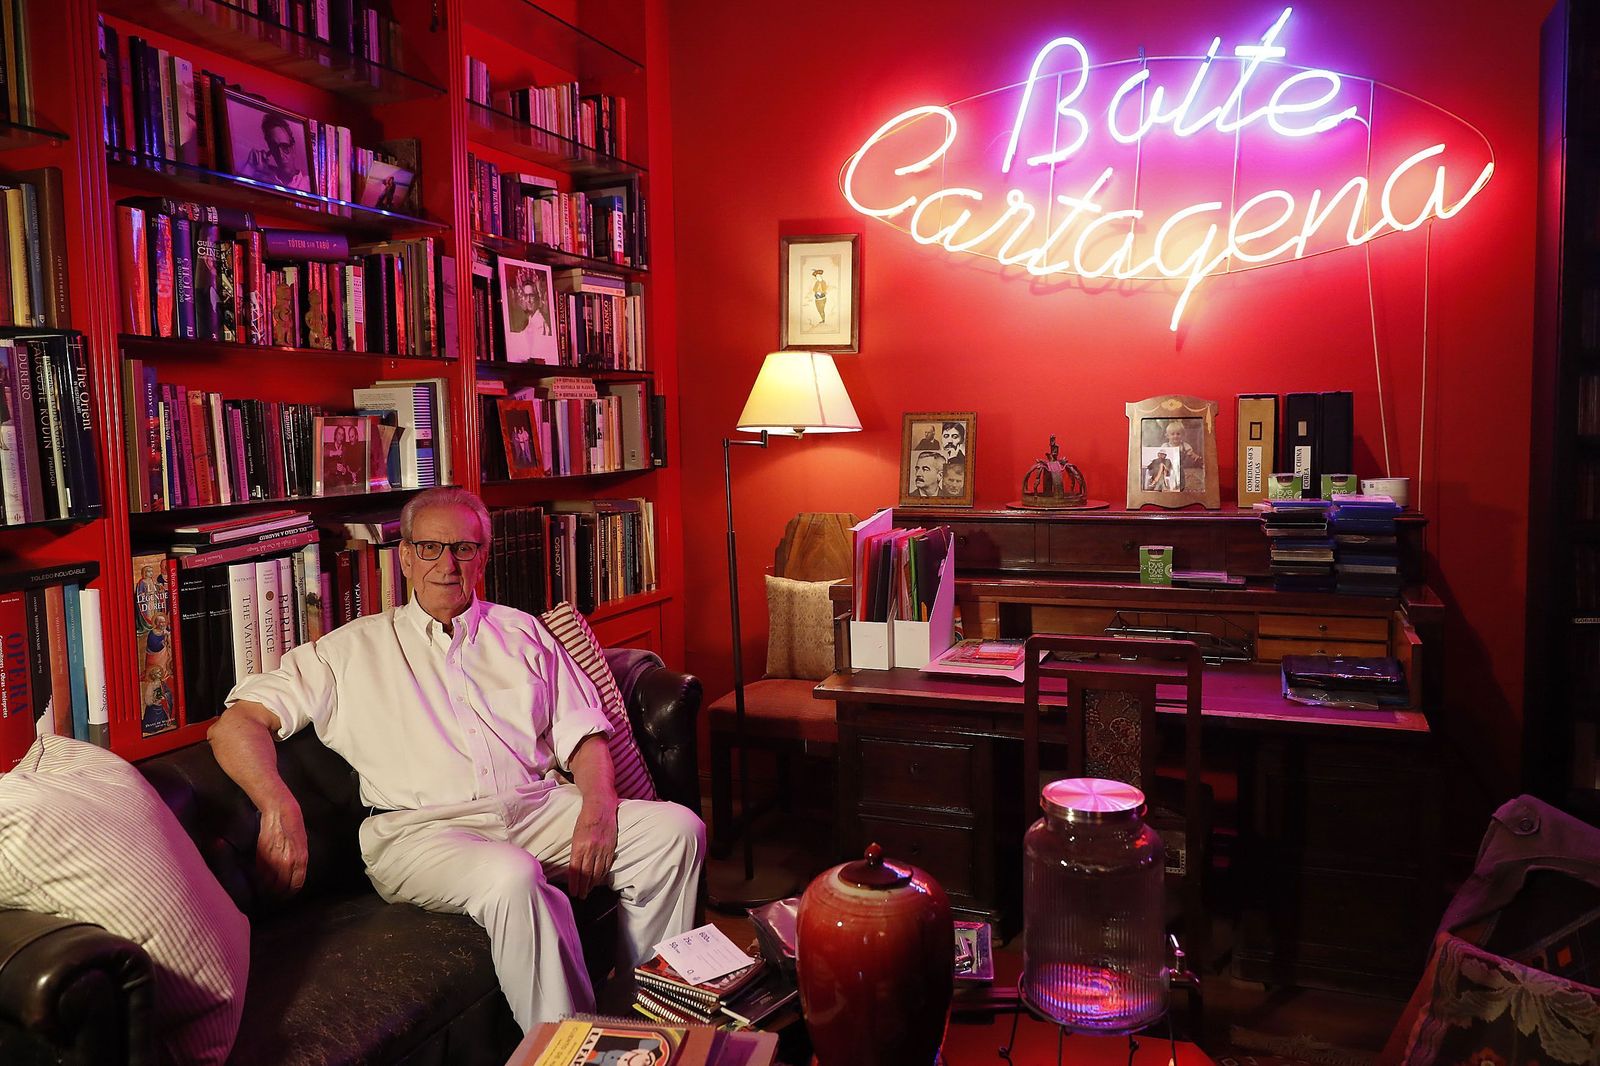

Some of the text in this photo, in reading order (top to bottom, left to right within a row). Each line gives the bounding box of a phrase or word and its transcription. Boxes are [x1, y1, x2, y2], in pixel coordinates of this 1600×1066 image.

[1002, 7, 1358, 173] Boite
[616, 213, 624, 249] PUENTE
[843, 104, 1495, 331] Cartagena
[197, 247, 220, 258] CINE
[18, 353, 31, 401] DURERO
[76, 366, 93, 431] The Orient
[39, 408, 52, 449] RODIN
[258, 531, 280, 541] MADRID
[554, 536, 562, 577] ALFONSO
[242, 594, 250, 622] THE
[353, 582, 361, 618] DALUCÍA
[265, 608, 275, 653] VENICE
[281, 594, 292, 652] BERLIN
[244, 624, 254, 674] VATICAN
[585, 1031, 599, 1045] LA
